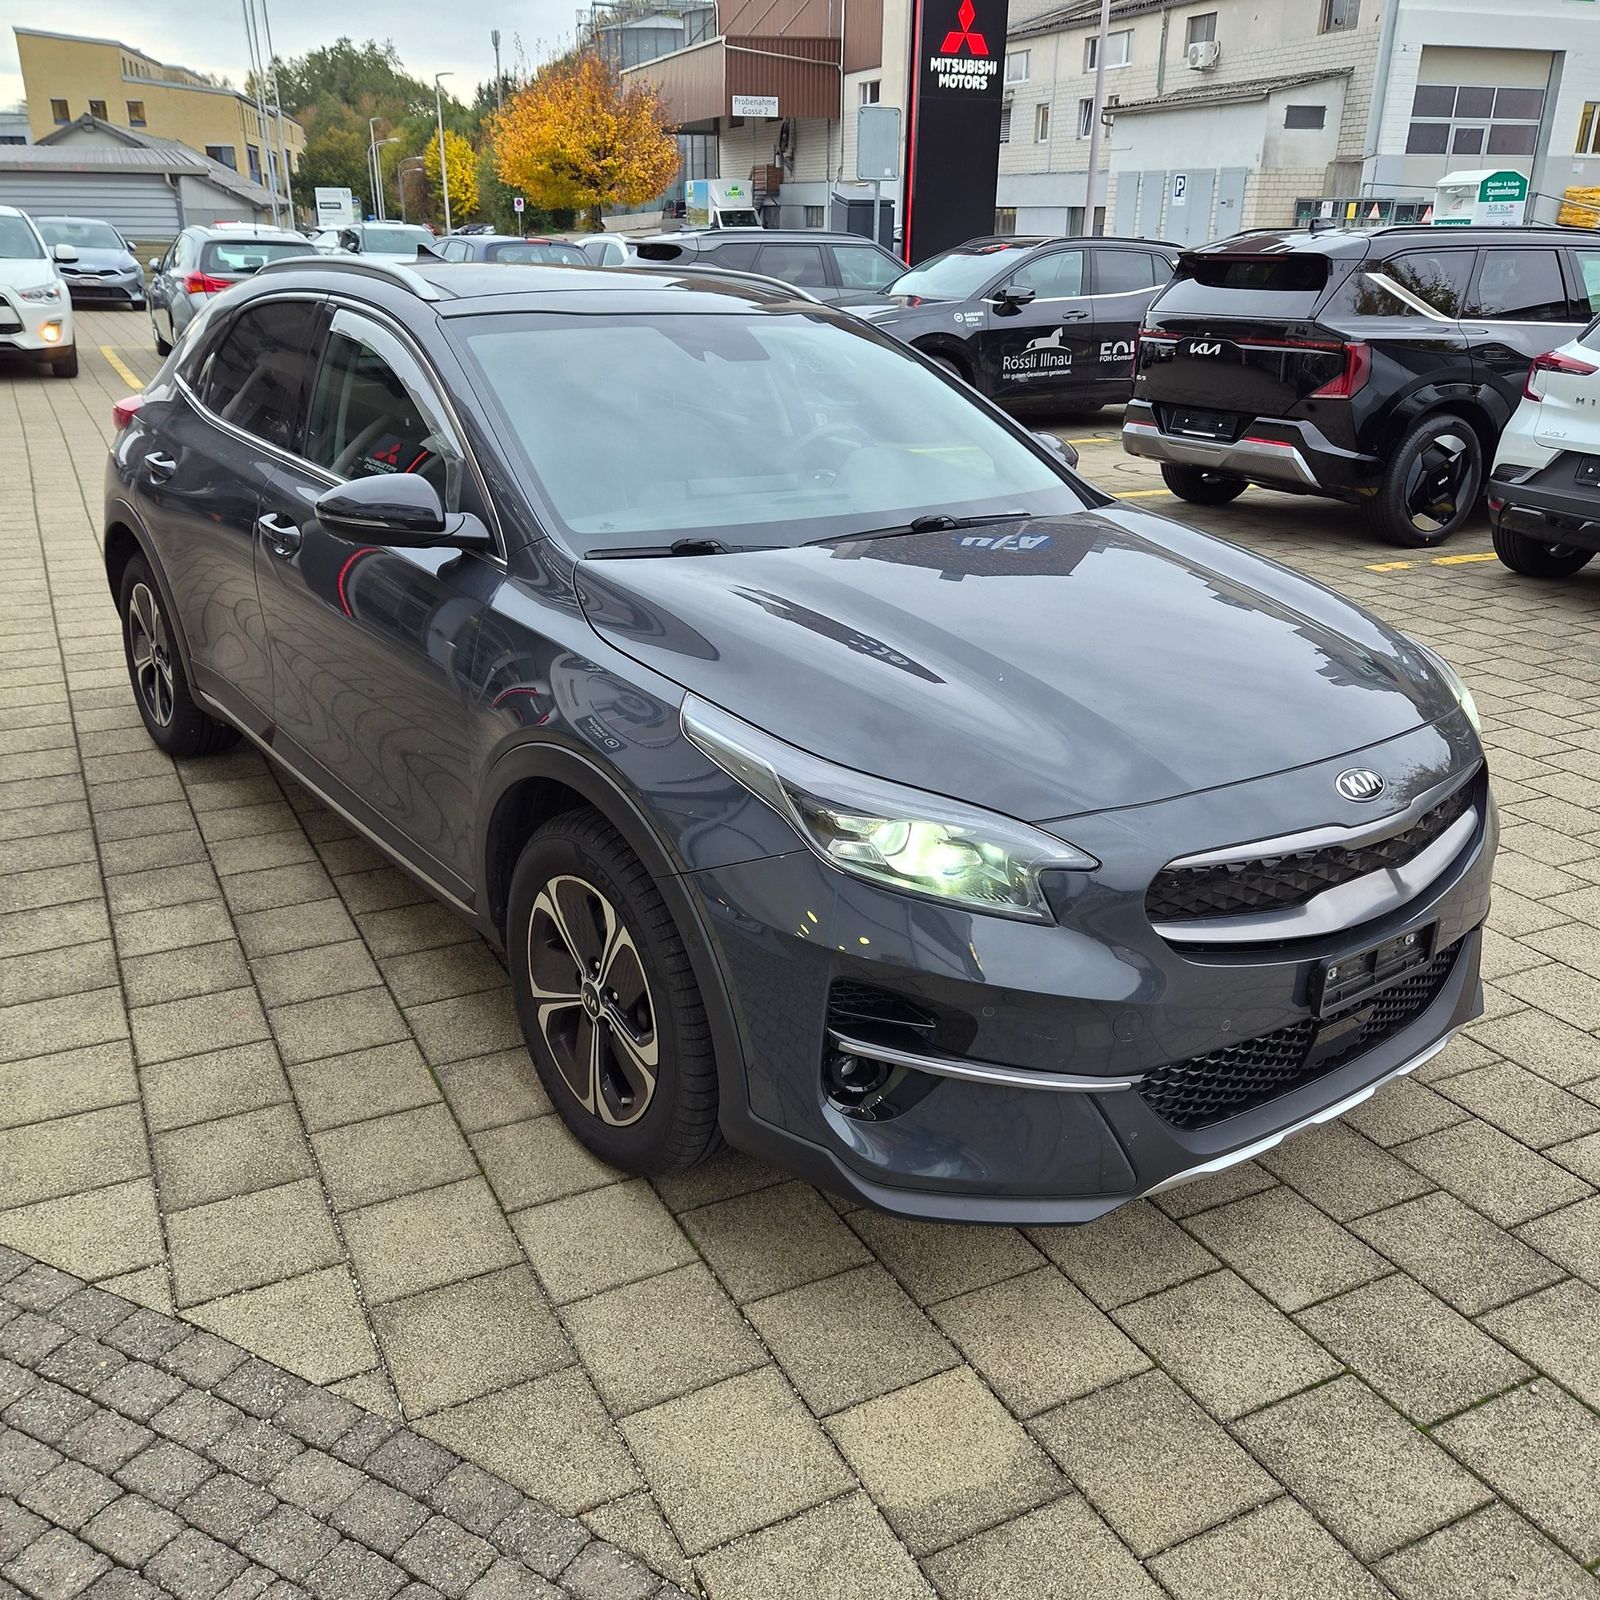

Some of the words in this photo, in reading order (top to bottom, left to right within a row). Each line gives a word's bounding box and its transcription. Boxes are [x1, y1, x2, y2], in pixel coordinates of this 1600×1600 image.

[930, 57, 997, 75] MITSUBISHI
[938, 74, 988, 90] MOTORS
[734, 97, 777, 106] Probenahme
[742, 107, 762, 115] Gosse
[764, 107, 769, 115] 2
[1176, 177, 1185, 196] P
[1486, 187, 1520, 197] Sammlung
[1002, 354, 1037, 370] Rössli
[1040, 352, 1073, 367] Illnau
[1341, 771, 1383, 796] KIA
